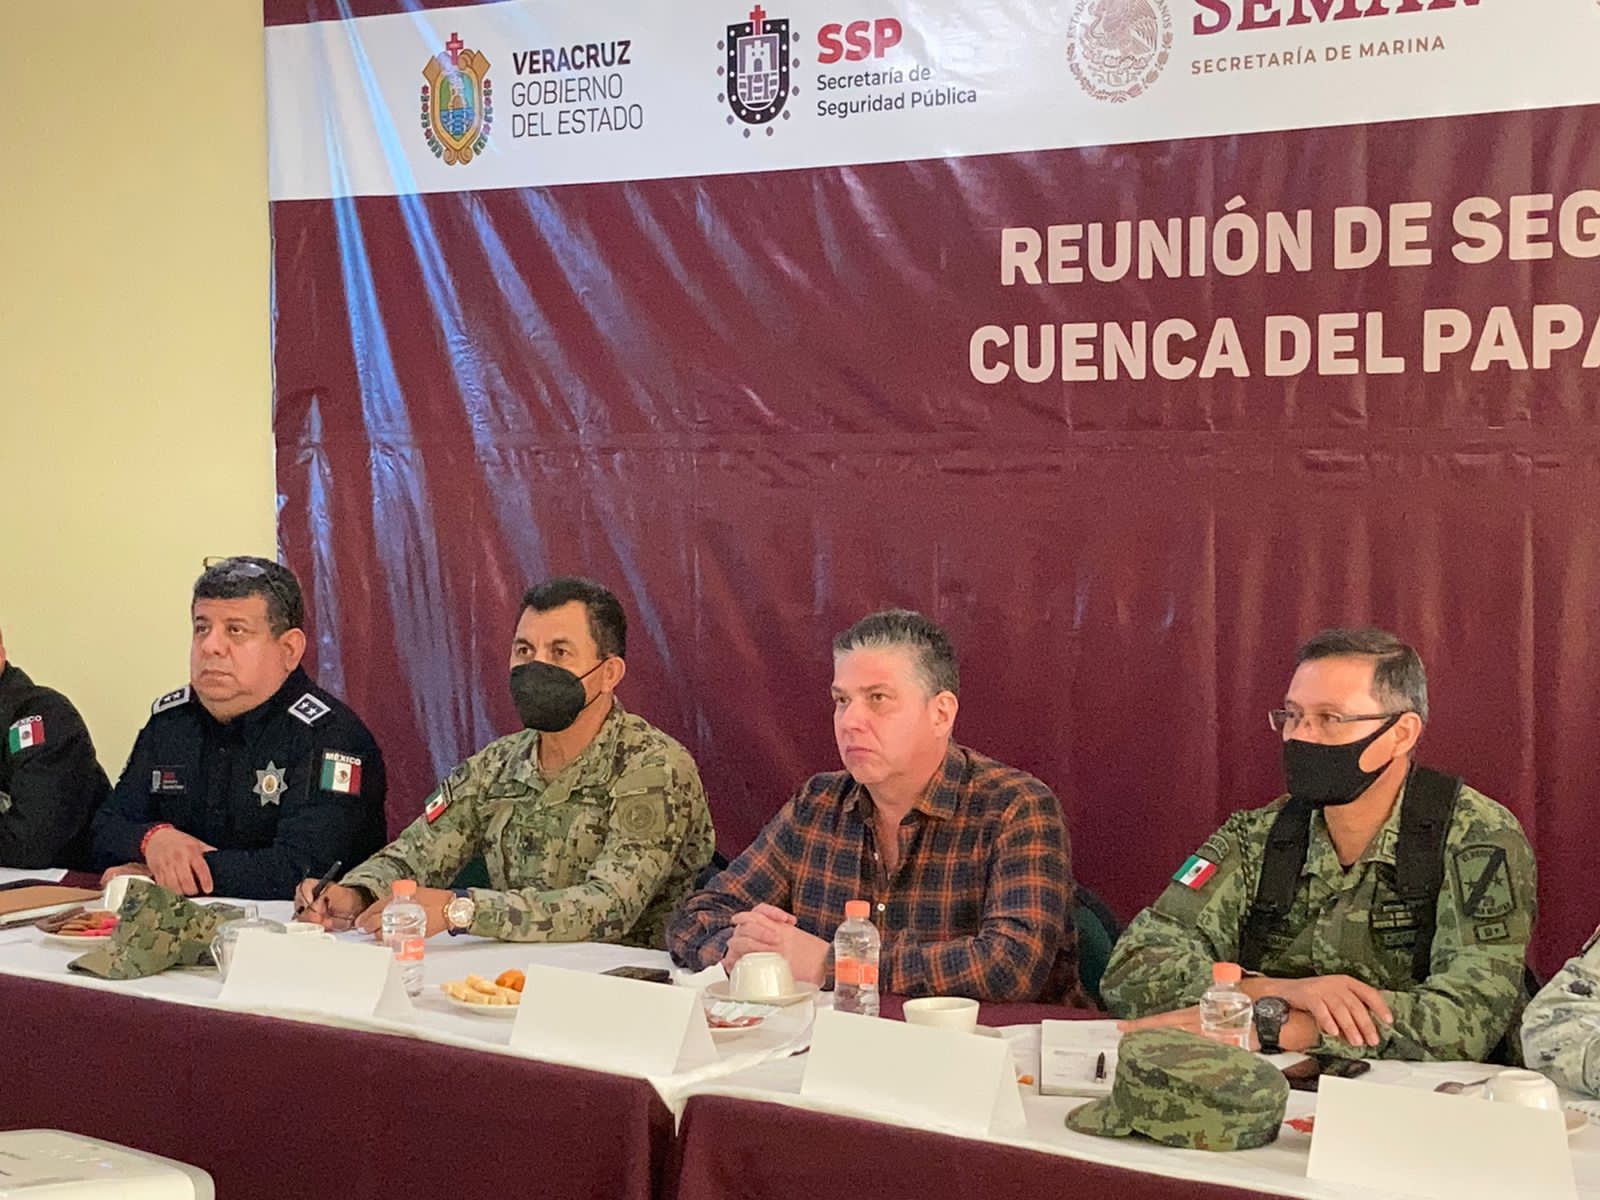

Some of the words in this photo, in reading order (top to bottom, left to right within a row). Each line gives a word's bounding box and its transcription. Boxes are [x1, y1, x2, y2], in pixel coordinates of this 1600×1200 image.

[513, 40, 630, 75] VERACRUZ
[818, 18, 902, 64] SSP
[1192, 47, 1316, 74] SECRETARÍA
[1326, 45, 1351, 61] DE
[1360, 36, 1444, 58] MARINA
[512, 73, 622, 107] GOBIERNO
[817, 72, 902, 90] Secretaría
[909, 65, 930, 81] de
[818, 93, 904, 118] Seguridad
[912, 88, 976, 108] Pública
[512, 112, 552, 138] DEL
[558, 104, 643, 134] ESTADO
[1001, 195, 1311, 285] REUNIÓN
[1335, 202, 1432, 269] DE
[970, 318, 1250, 383] CUENCA
[1265, 312, 1404, 376] DEL
